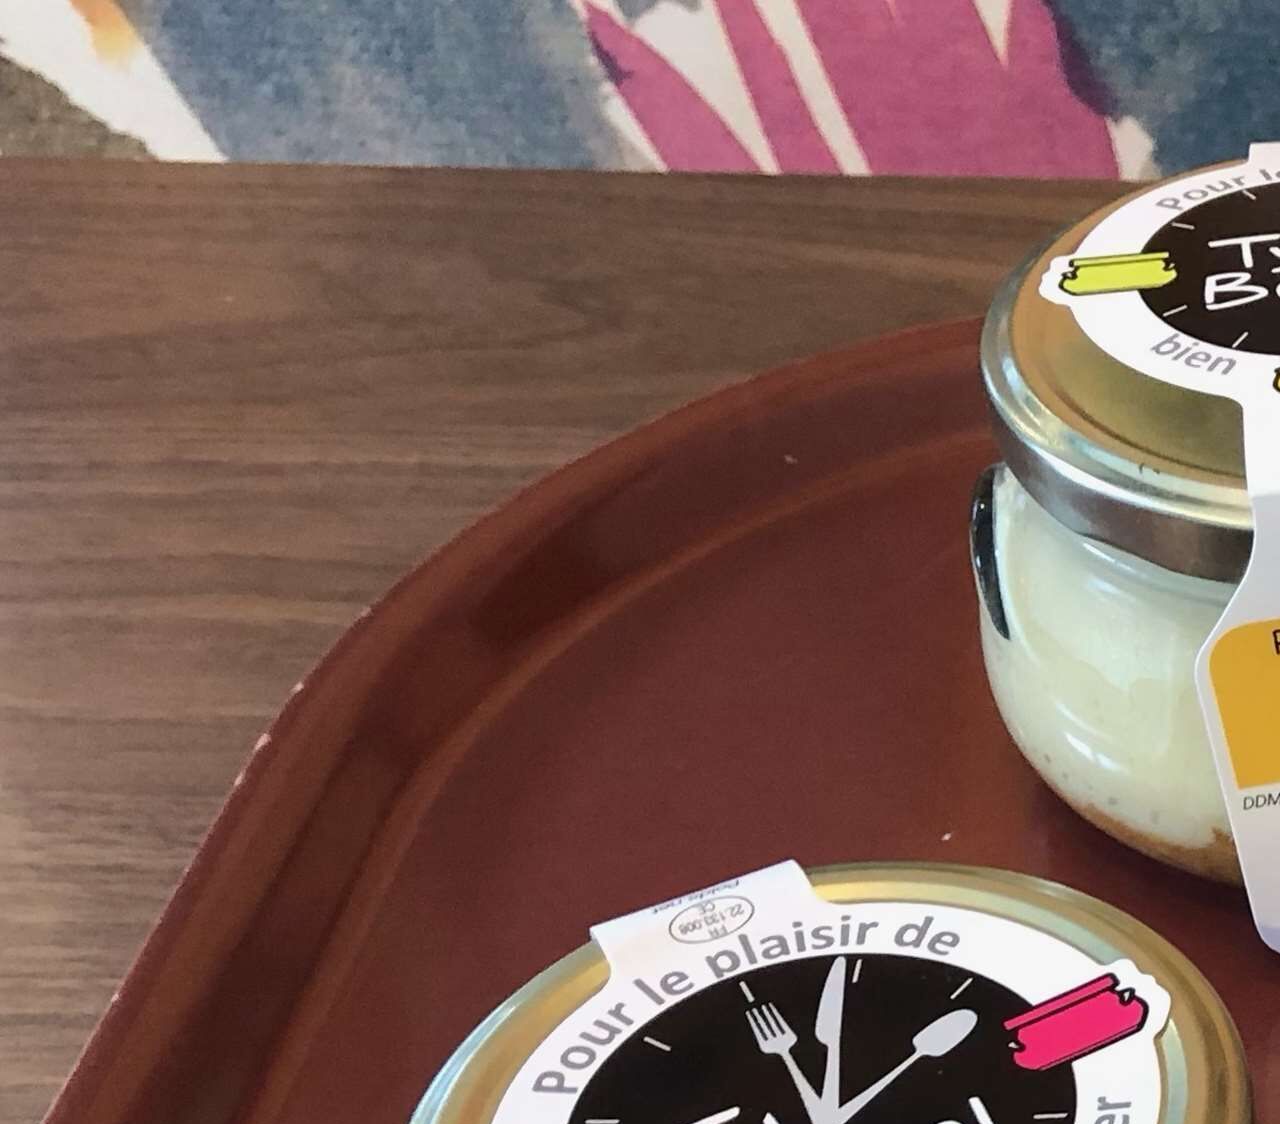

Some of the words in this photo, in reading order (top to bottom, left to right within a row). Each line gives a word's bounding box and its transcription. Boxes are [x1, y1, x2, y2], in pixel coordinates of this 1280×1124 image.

[1155, 172, 1249, 211] Pour
[1150, 333, 1238, 378] bien
[531, 998, 632, 1099] Pour
[632, 966, 696, 1000] le
[707, 914, 880, 983] plaisir
[894, 912, 963, 959] de
